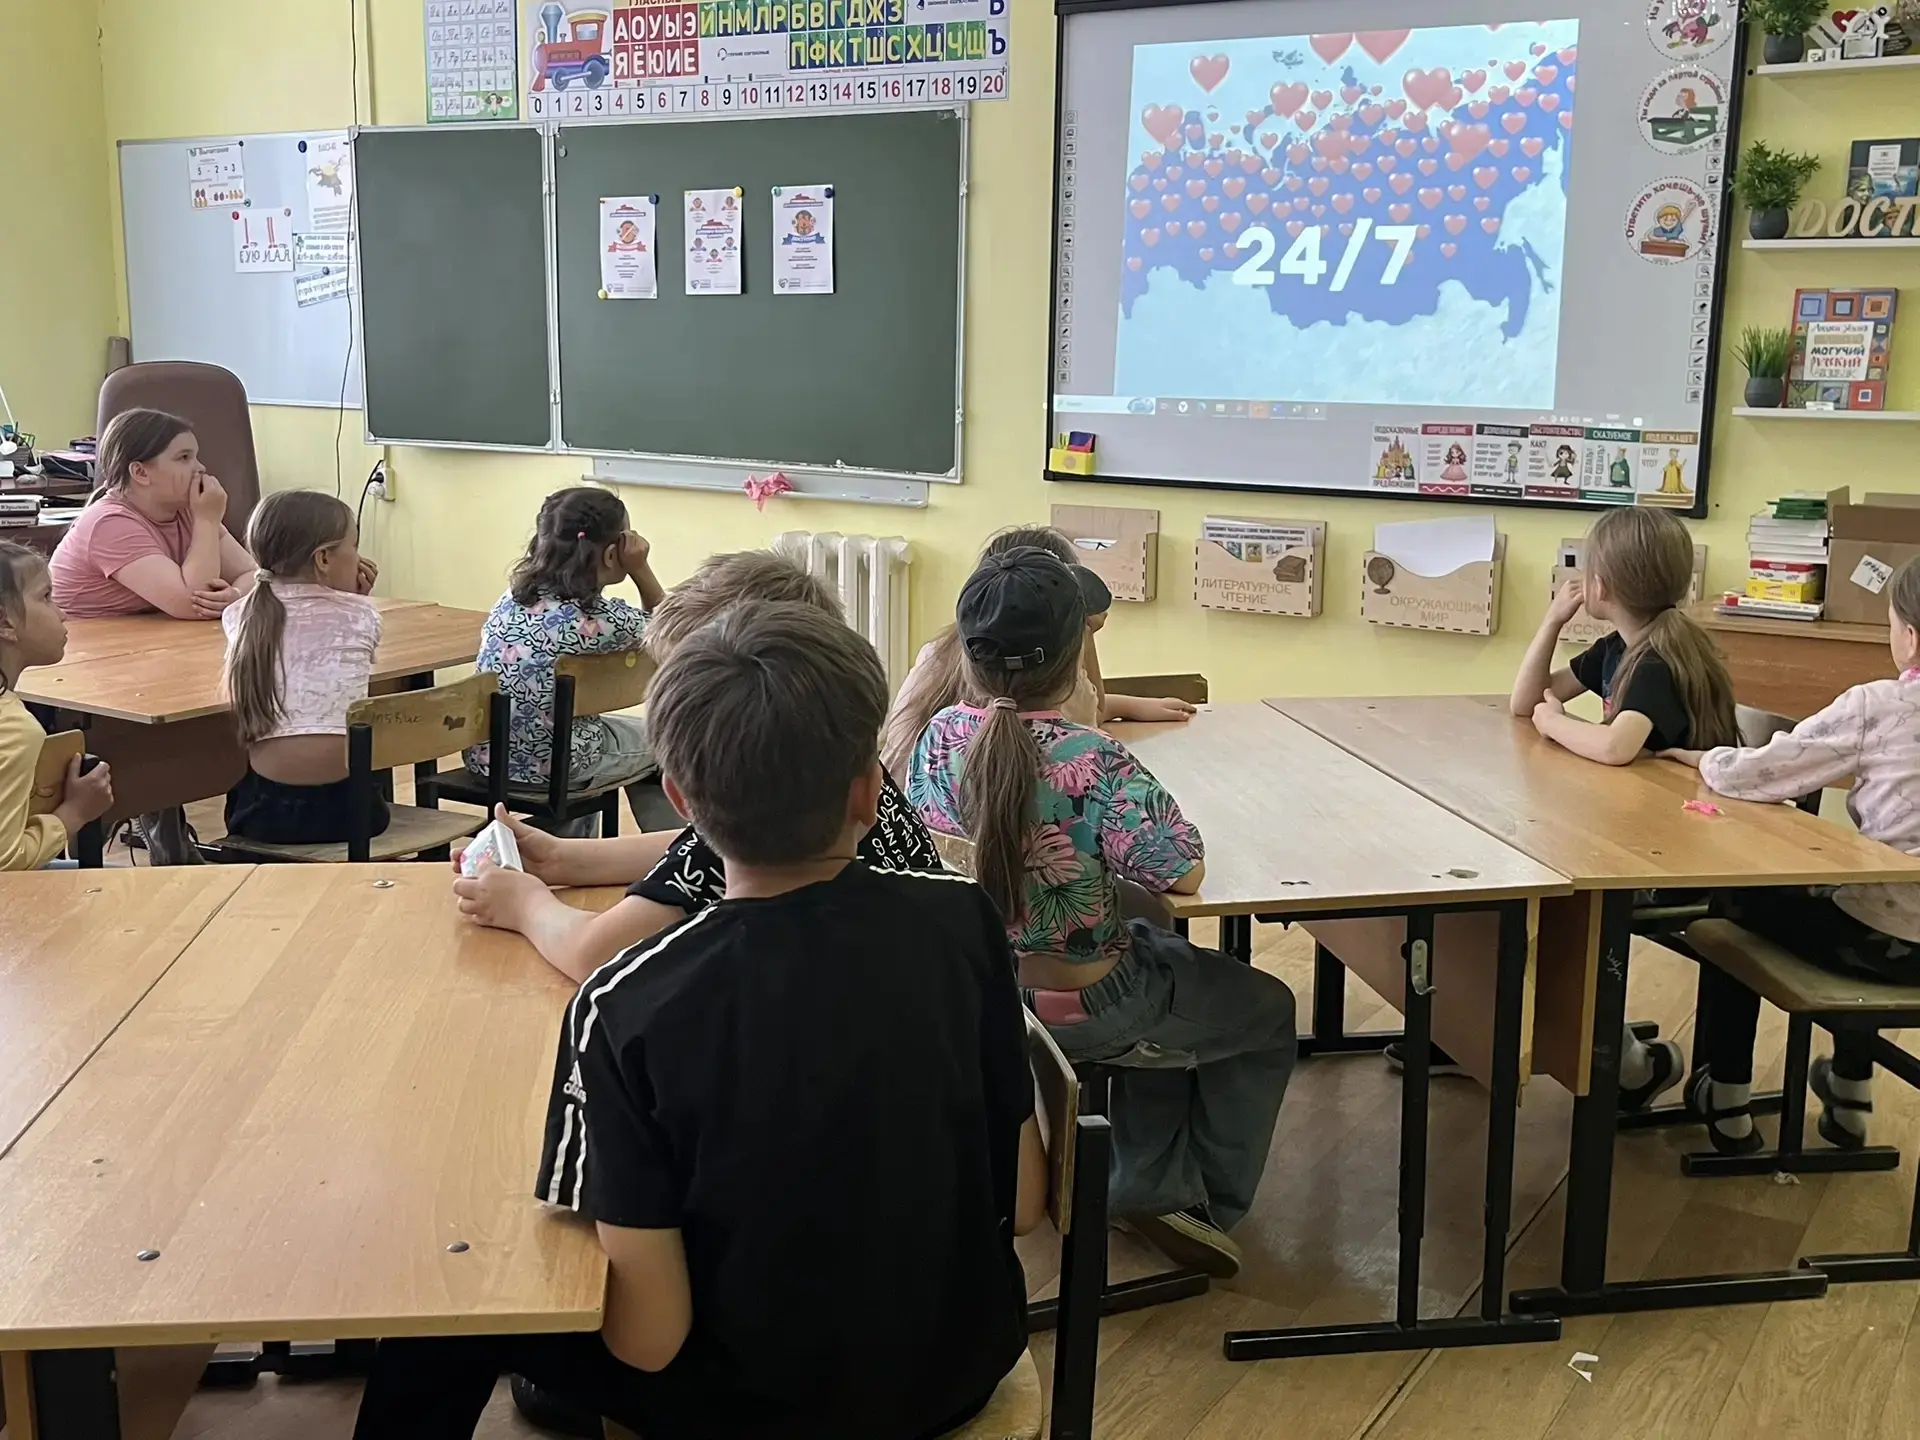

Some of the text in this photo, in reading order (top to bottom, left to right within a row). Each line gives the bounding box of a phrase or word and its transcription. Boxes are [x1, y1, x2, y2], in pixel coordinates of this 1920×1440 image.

[534, 74, 1004, 114] 0 1 2 3 4 5 6 7 8 9 10 11 12 13 14 15 16 17 18 19 20
[1625, 192, 1653, 238] Ответить
[1784, 196, 1920, 238] ДОСТ
[1232, 217, 1419, 292] 24/7
[1811, 344, 1866, 356] МОГУЧИЙ
[1592, 430, 1633, 441] СКАЗУЕМОЕ
[1106, 580, 1140, 592] АТИКА
[1201, 578, 1292, 595] ЛИТЕРАТУРНОЕ
[1221, 591, 1268, 605] ЧТЕНИЕ
[1390, 595, 1487, 615] ОКРУЖАЮЩИЙ
[1420, 610, 1450, 623] МИР
